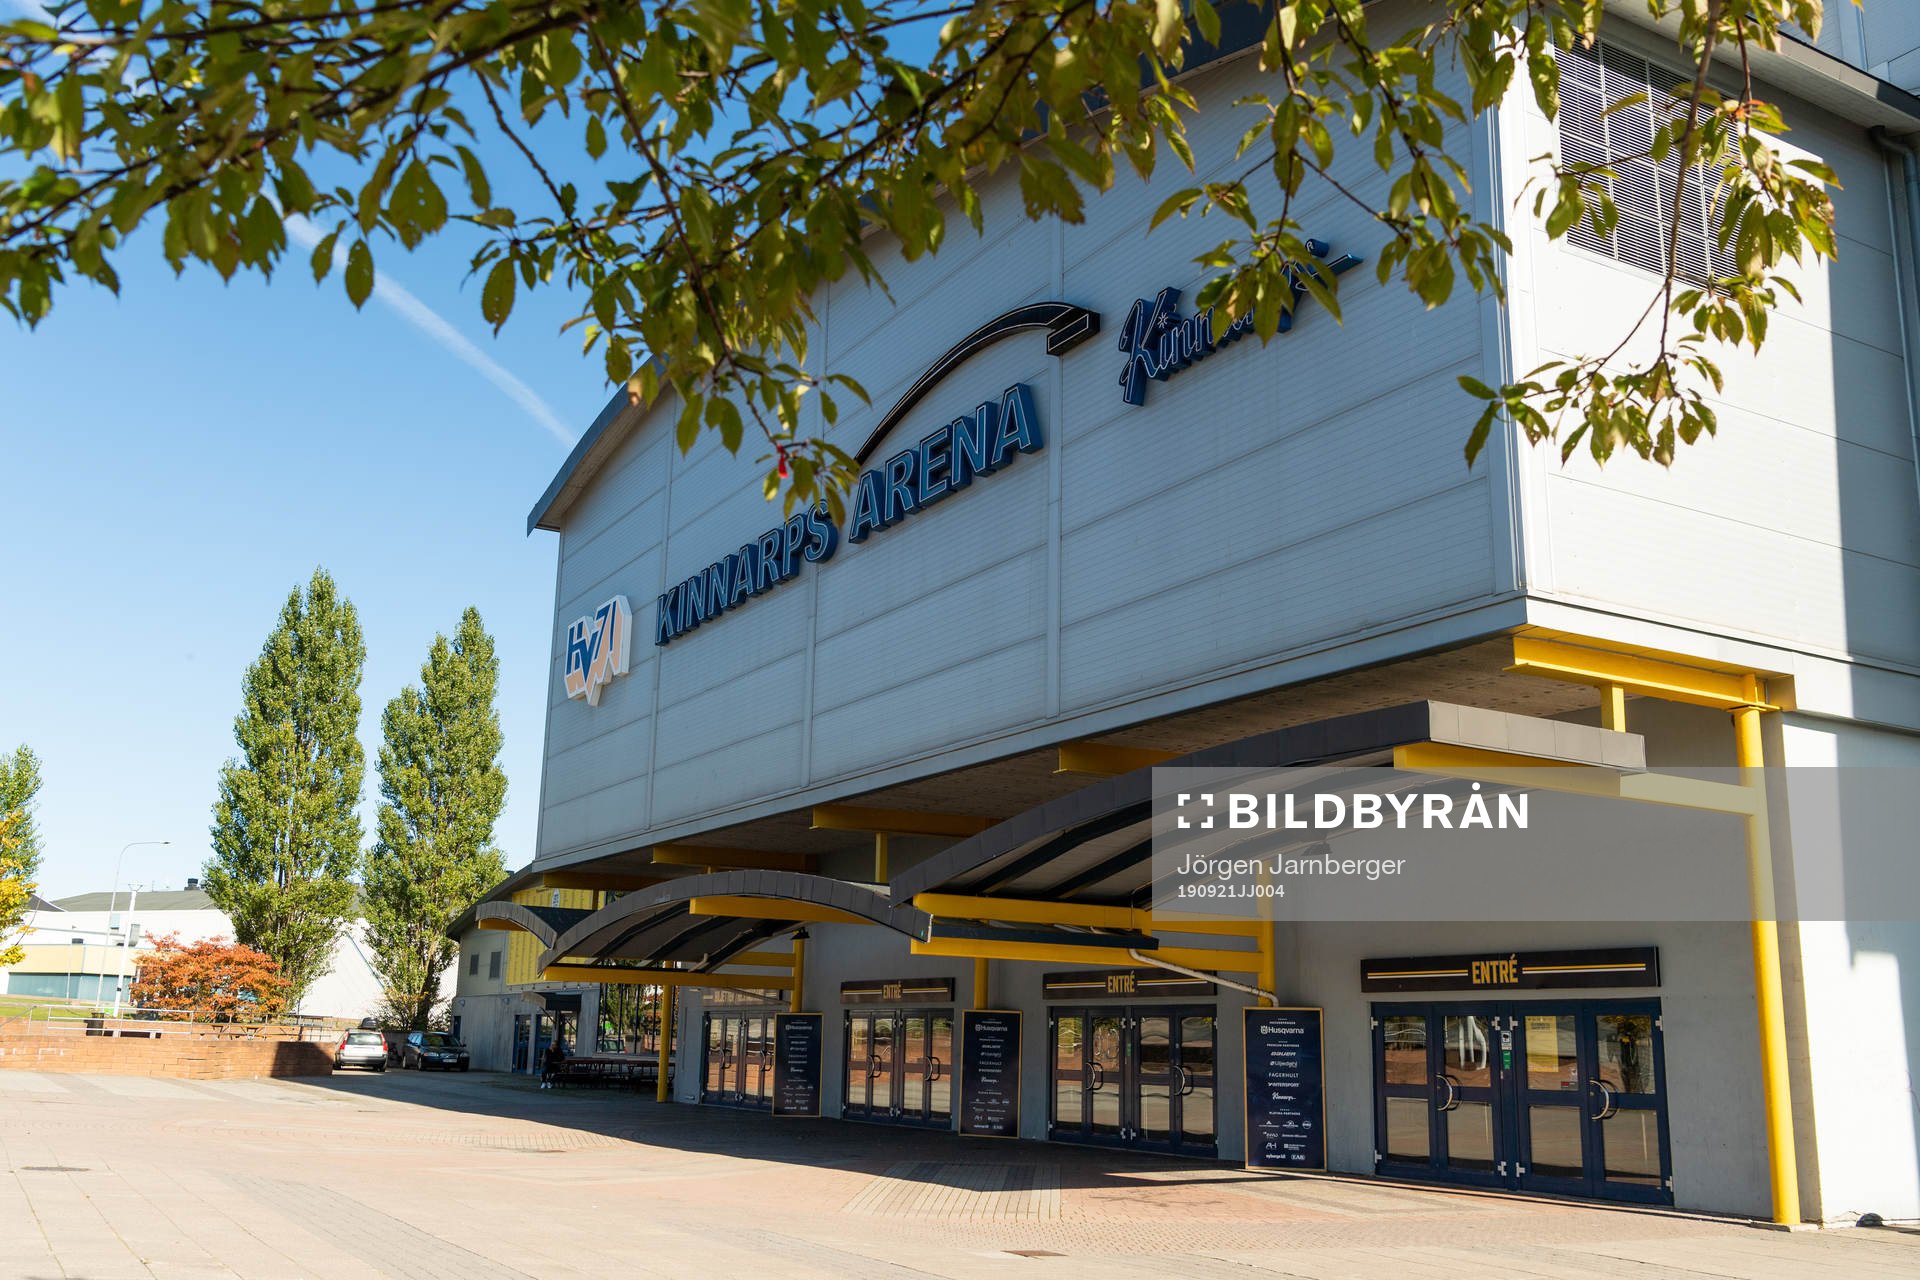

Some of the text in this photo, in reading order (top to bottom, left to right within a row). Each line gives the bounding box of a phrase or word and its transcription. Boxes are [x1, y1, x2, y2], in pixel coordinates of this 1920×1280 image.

[655, 382, 1044, 646] KINNARPS ARENA
[565, 597, 620, 685] HV71
[1107, 971, 1136, 993] ENTRÉ
[1472, 953, 1519, 985] ENTRÉ
[883, 981, 903, 999] ENTRÉ
[1268, 1026, 1305, 1035] Husqvarna
